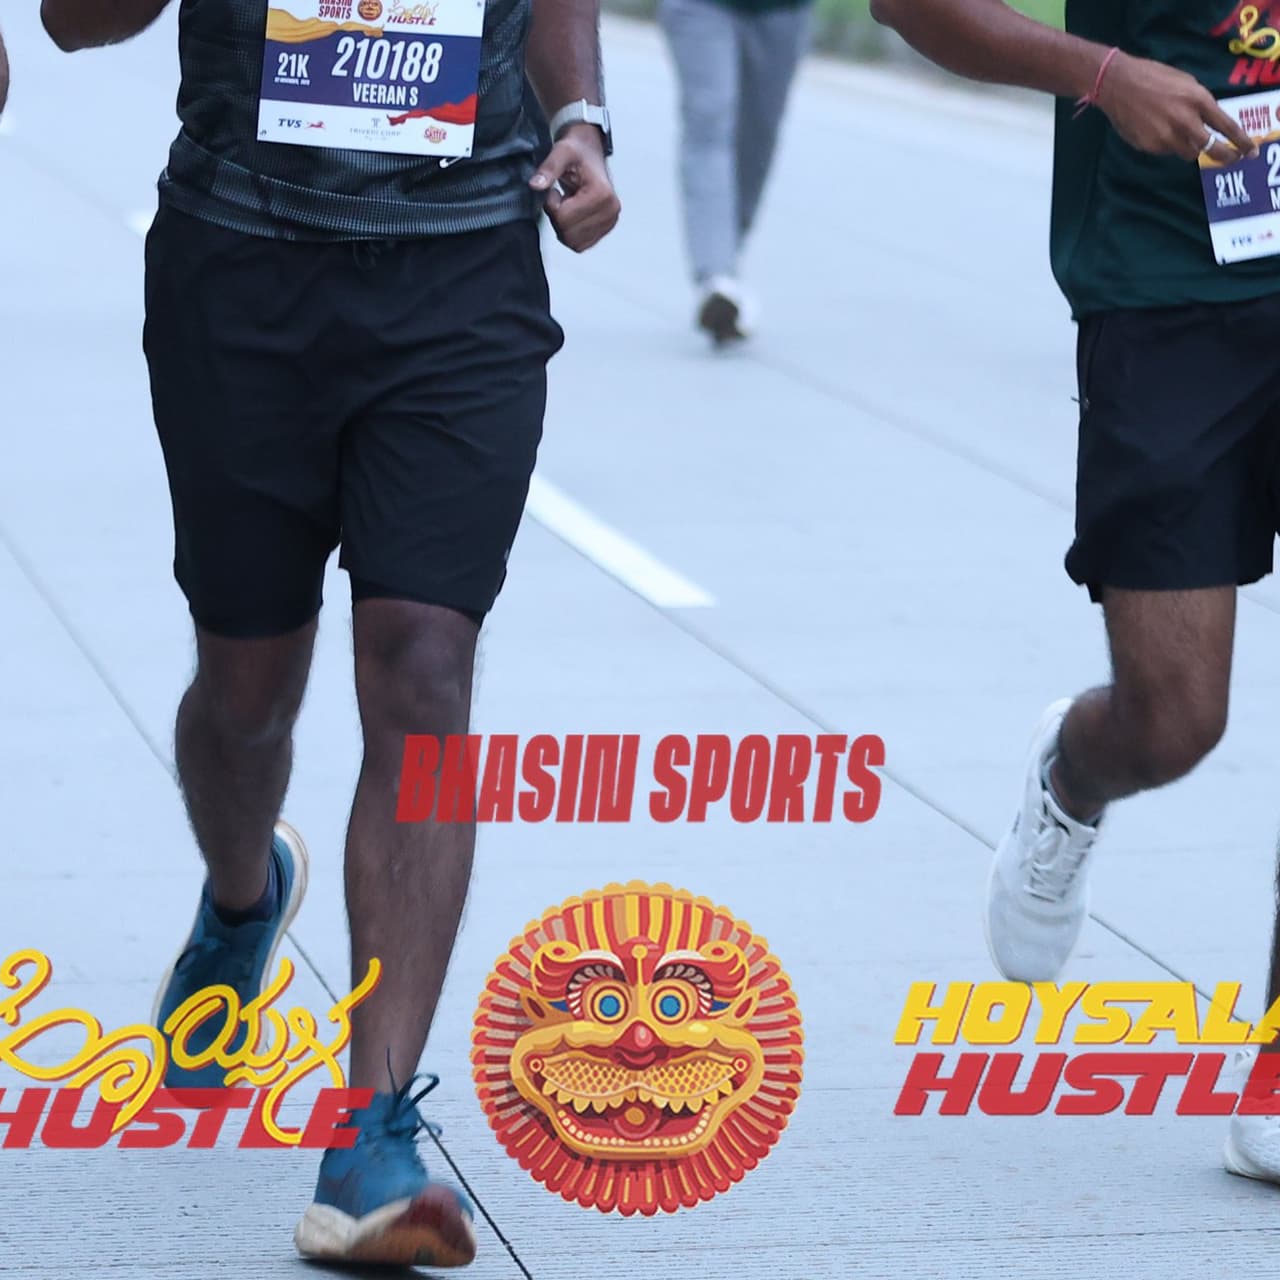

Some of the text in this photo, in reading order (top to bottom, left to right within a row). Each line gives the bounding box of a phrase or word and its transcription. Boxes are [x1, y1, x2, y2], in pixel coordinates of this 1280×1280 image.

[318, 6, 352, 19] SPORTS
[278, 52, 310, 78] 21K
[331, 36, 443, 83] 210188
[352, 82, 419, 107] VEERAN S
[278, 118, 302, 129] TVS
[1215, 170, 1245, 197] 21K
